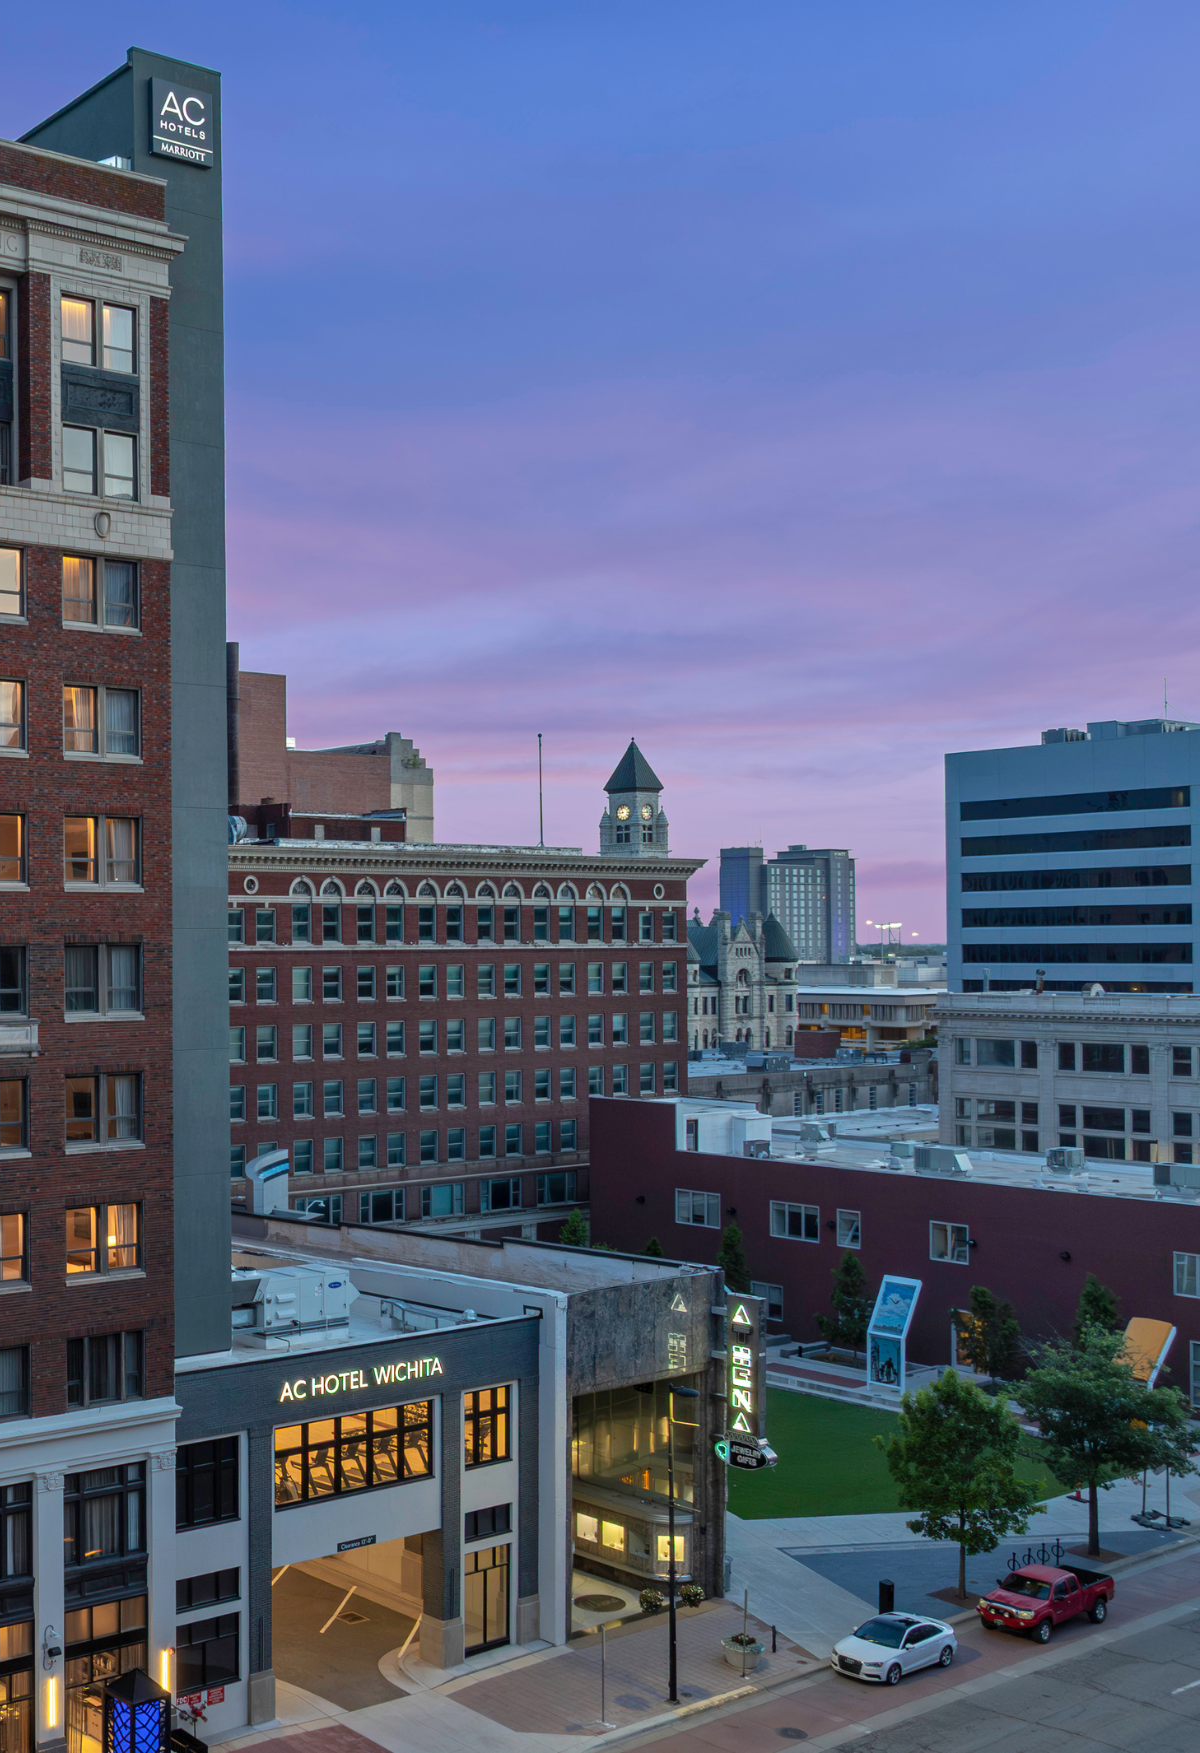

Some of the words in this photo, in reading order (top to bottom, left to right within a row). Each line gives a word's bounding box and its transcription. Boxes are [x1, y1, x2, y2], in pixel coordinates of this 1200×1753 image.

[160, 91, 205, 126] AC
[160, 119, 206, 140] HOTELS
[161, 142, 206, 162] MARRIOTT
[280, 1381, 307, 1403] AC
[311, 1369, 369, 1397] HOTEL
[373, 1356, 443, 1385] WICHITA
[731, 1444, 762, 1459] JEWELRY
[736, 1454, 757, 1467] GIFTS
